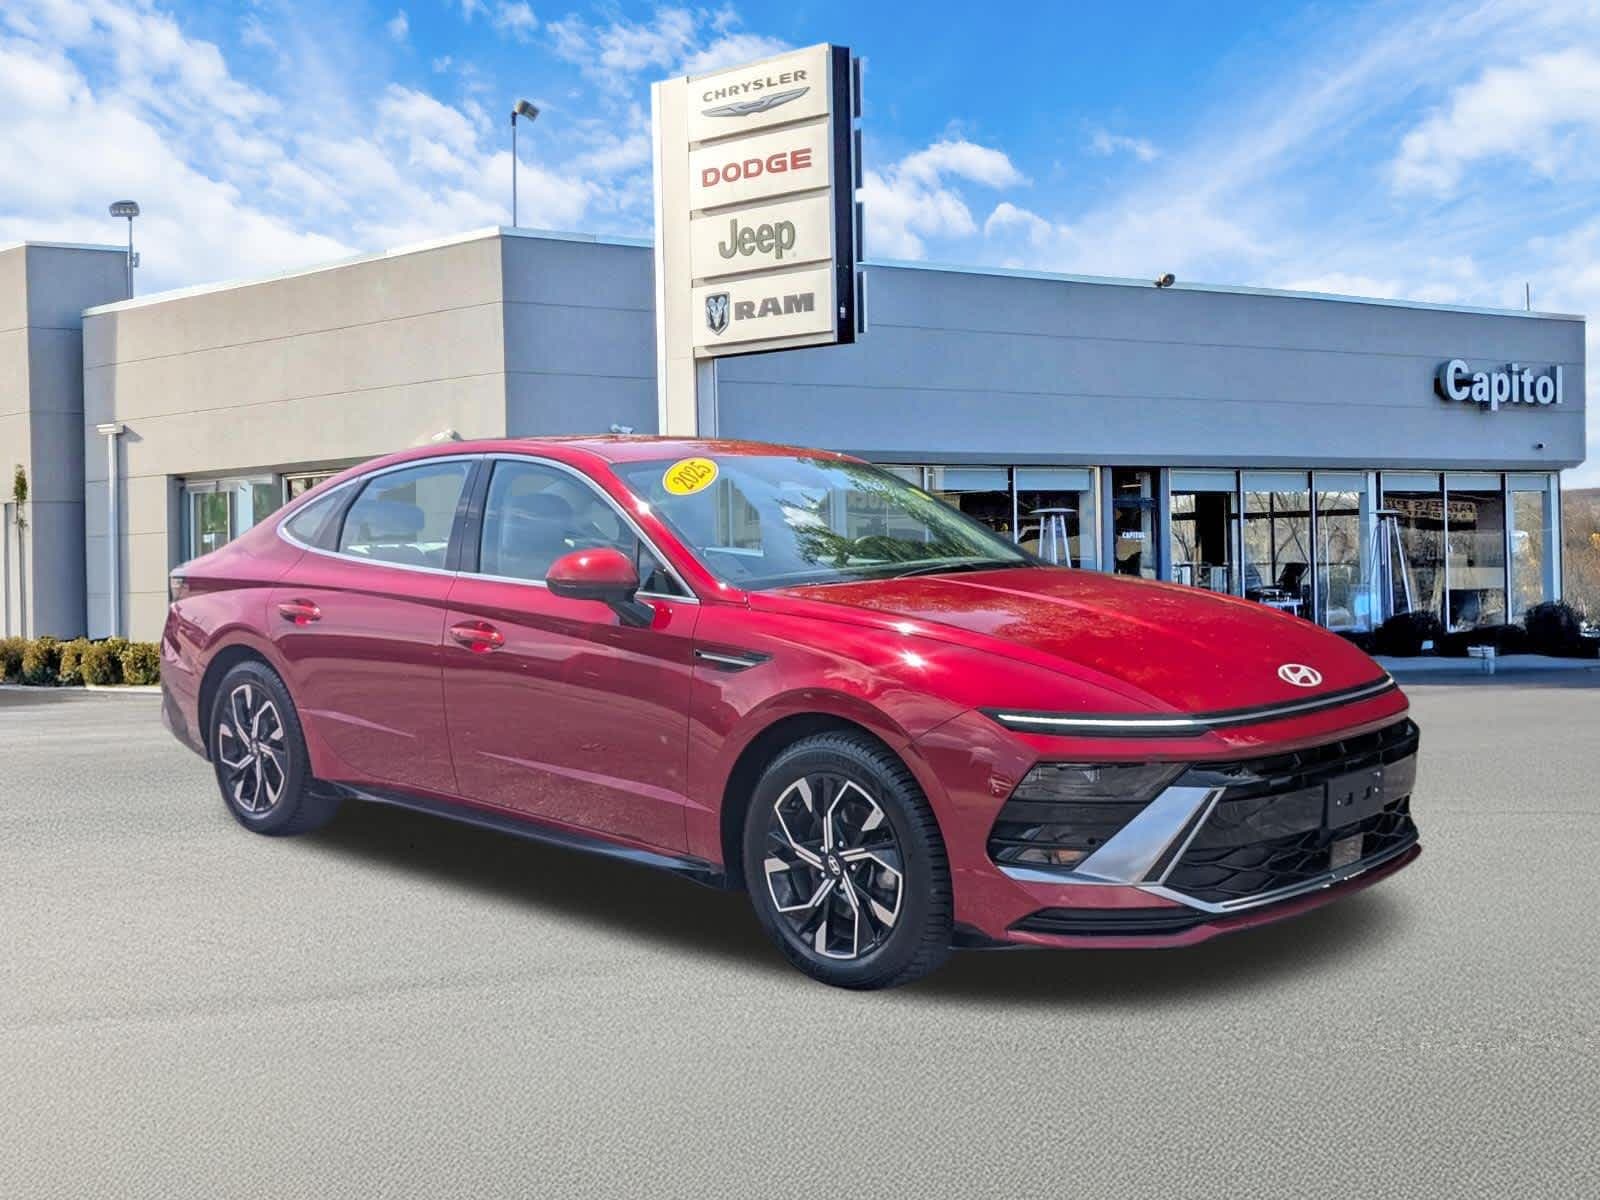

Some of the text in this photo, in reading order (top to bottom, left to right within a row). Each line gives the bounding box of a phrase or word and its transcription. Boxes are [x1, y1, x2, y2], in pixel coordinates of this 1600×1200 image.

[703, 70, 808, 102] CHRYSLER
[702, 148, 812, 187] DODGE
[718, 218, 796, 259] Jeep
[734, 292, 815, 320] RAM
[1446, 359, 1563, 411] Capitol
[672, 461, 711, 490] 2025
